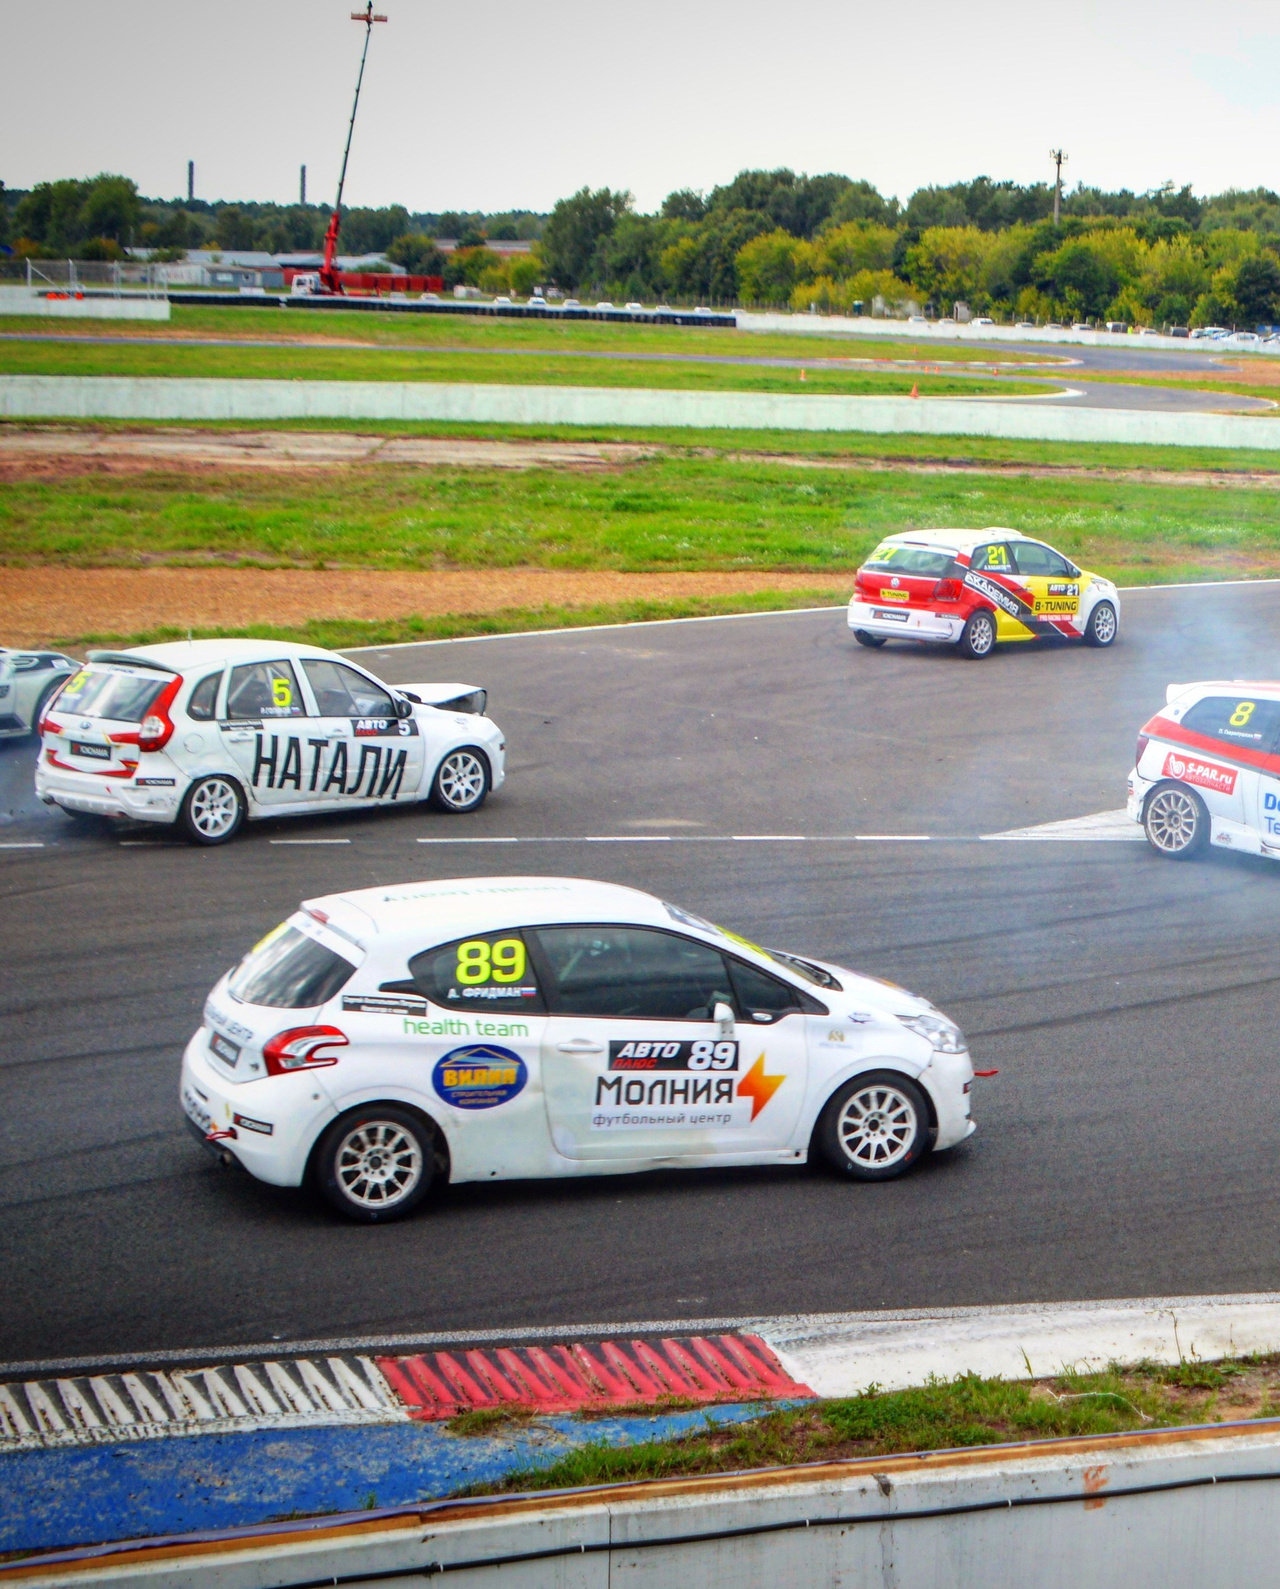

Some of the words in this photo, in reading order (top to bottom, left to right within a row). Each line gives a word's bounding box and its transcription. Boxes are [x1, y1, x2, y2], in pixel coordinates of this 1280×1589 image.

[987, 545, 1007, 565] 21
[964, 572, 1019, 615] АКАДЕМИЯ
[1066, 583, 1079, 596] 21
[65, 671, 93, 694] 5
[272, 678, 292, 707] 5
[1229, 701, 1256, 726] 8
[356, 719, 388, 730] АВТО
[398, 719, 411, 736] 5
[252, 733, 408, 800] НАТАЛИ
[1187, 762, 1233, 785] S-PAR.ru
[456, 939, 526, 985] 89
[447, 988, 460, 999] А.
[403, 1018, 470, 1036] health
[475, 1019, 530, 1037] team
[617, 1042, 681, 1058] АВТО
[687, 1040, 736, 1070] 89
[611, 1058, 658, 1069] ПЛЮС
[443, 1068, 517, 1087] ВИЛИЯ
[593, 1112, 686, 1127] футбольный
[689, 1112, 732, 1125] центр
